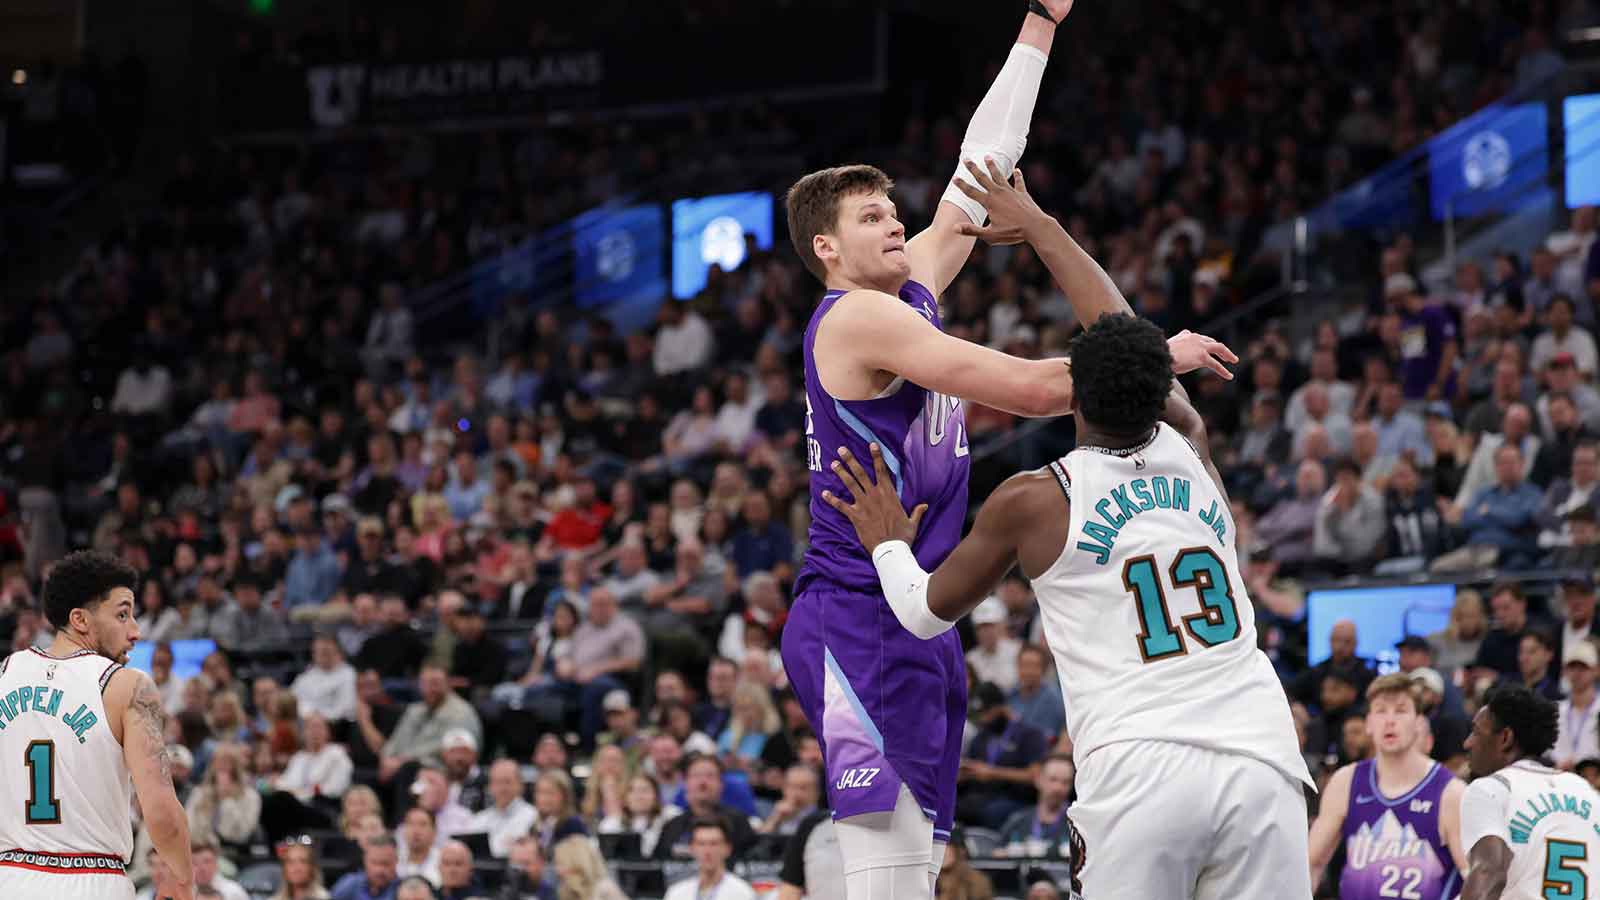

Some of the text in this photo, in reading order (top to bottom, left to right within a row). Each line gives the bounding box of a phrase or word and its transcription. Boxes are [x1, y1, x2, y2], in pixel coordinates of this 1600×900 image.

[371, 60, 492, 97] HEALTH
[497, 51, 602, 91] PLANS
[1077, 476, 1190, 565] JACKSON
[1121, 546, 1242, 664] 13
[62, 703, 97, 744] JR.
[24, 739, 61, 824] 1
[836, 767, 881, 790] JAZZ
[1507, 792, 1592, 844] WILLIAMS
[1350, 834, 1422, 870] UTAH
[1541, 838, 1589, 900] 5
[1379, 864, 1422, 900] 22
